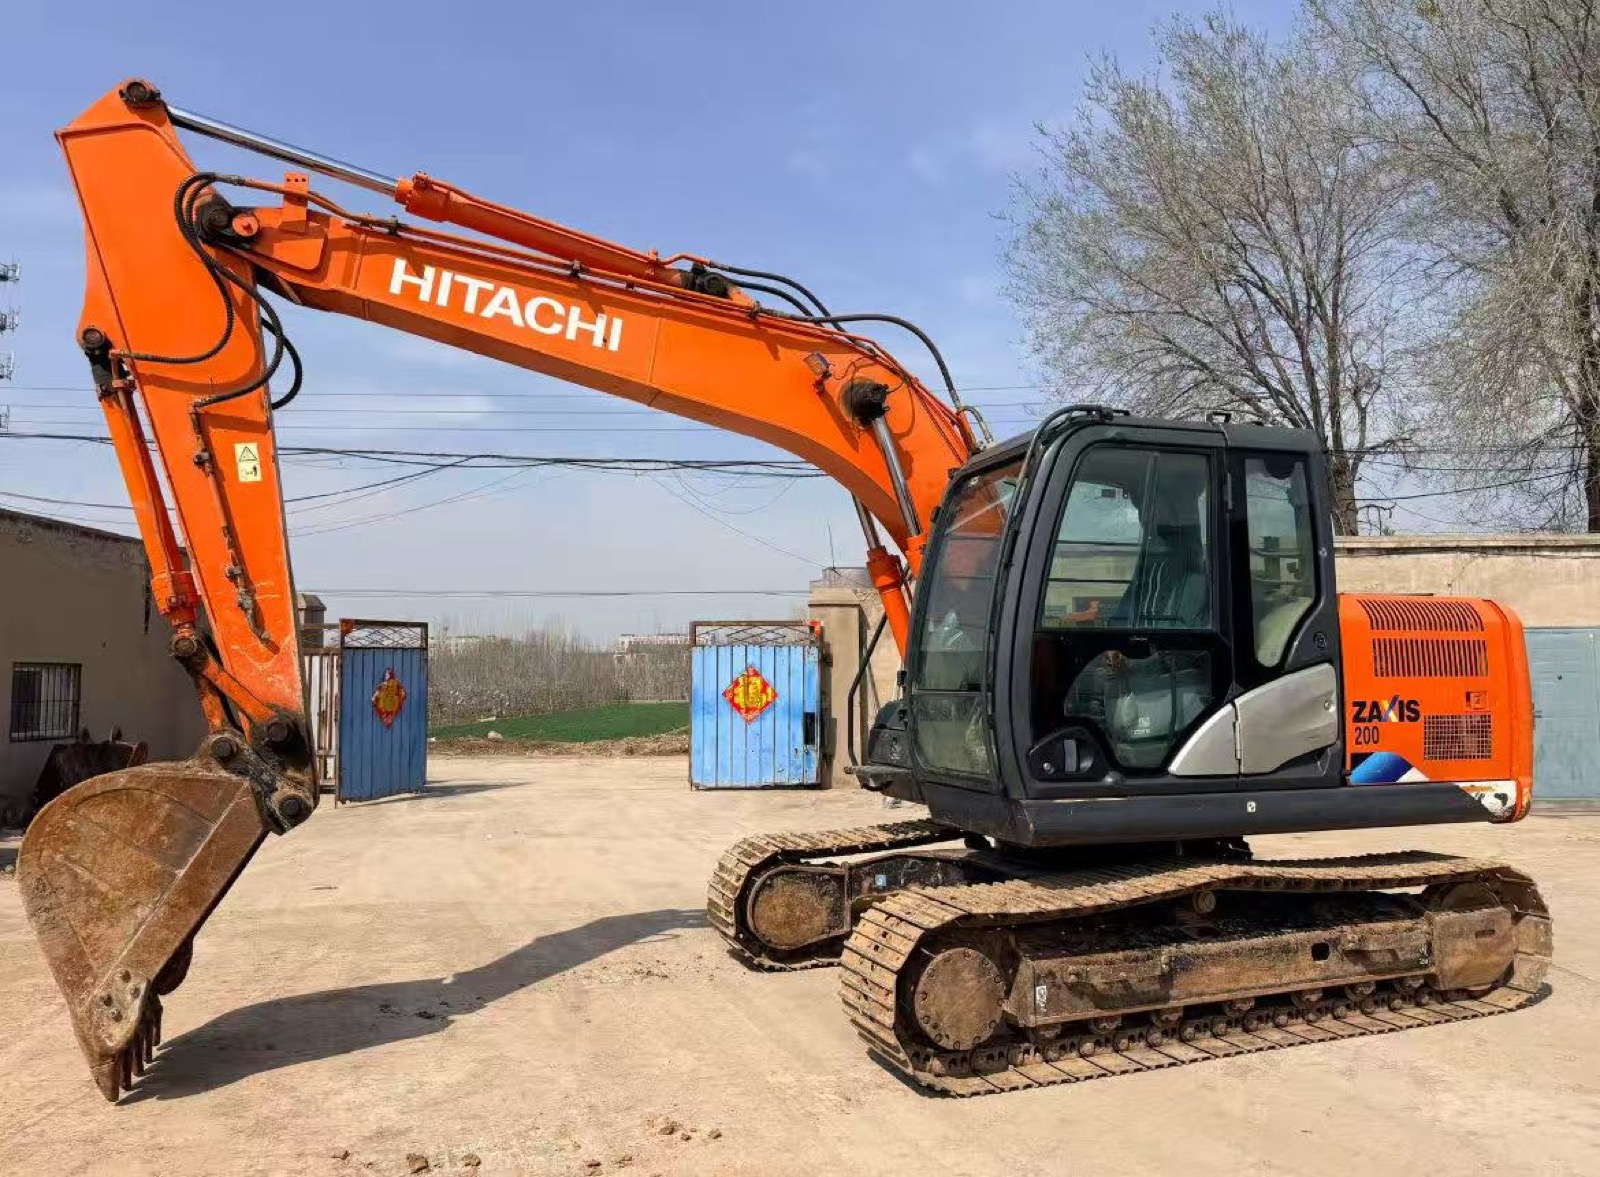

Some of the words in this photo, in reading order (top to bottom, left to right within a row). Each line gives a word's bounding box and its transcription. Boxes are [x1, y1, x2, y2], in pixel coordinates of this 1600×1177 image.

[389, 257, 623, 351] HITACHI
[1352, 694, 1421, 723] ZAXIS
[1354, 725, 1380, 746] 200
